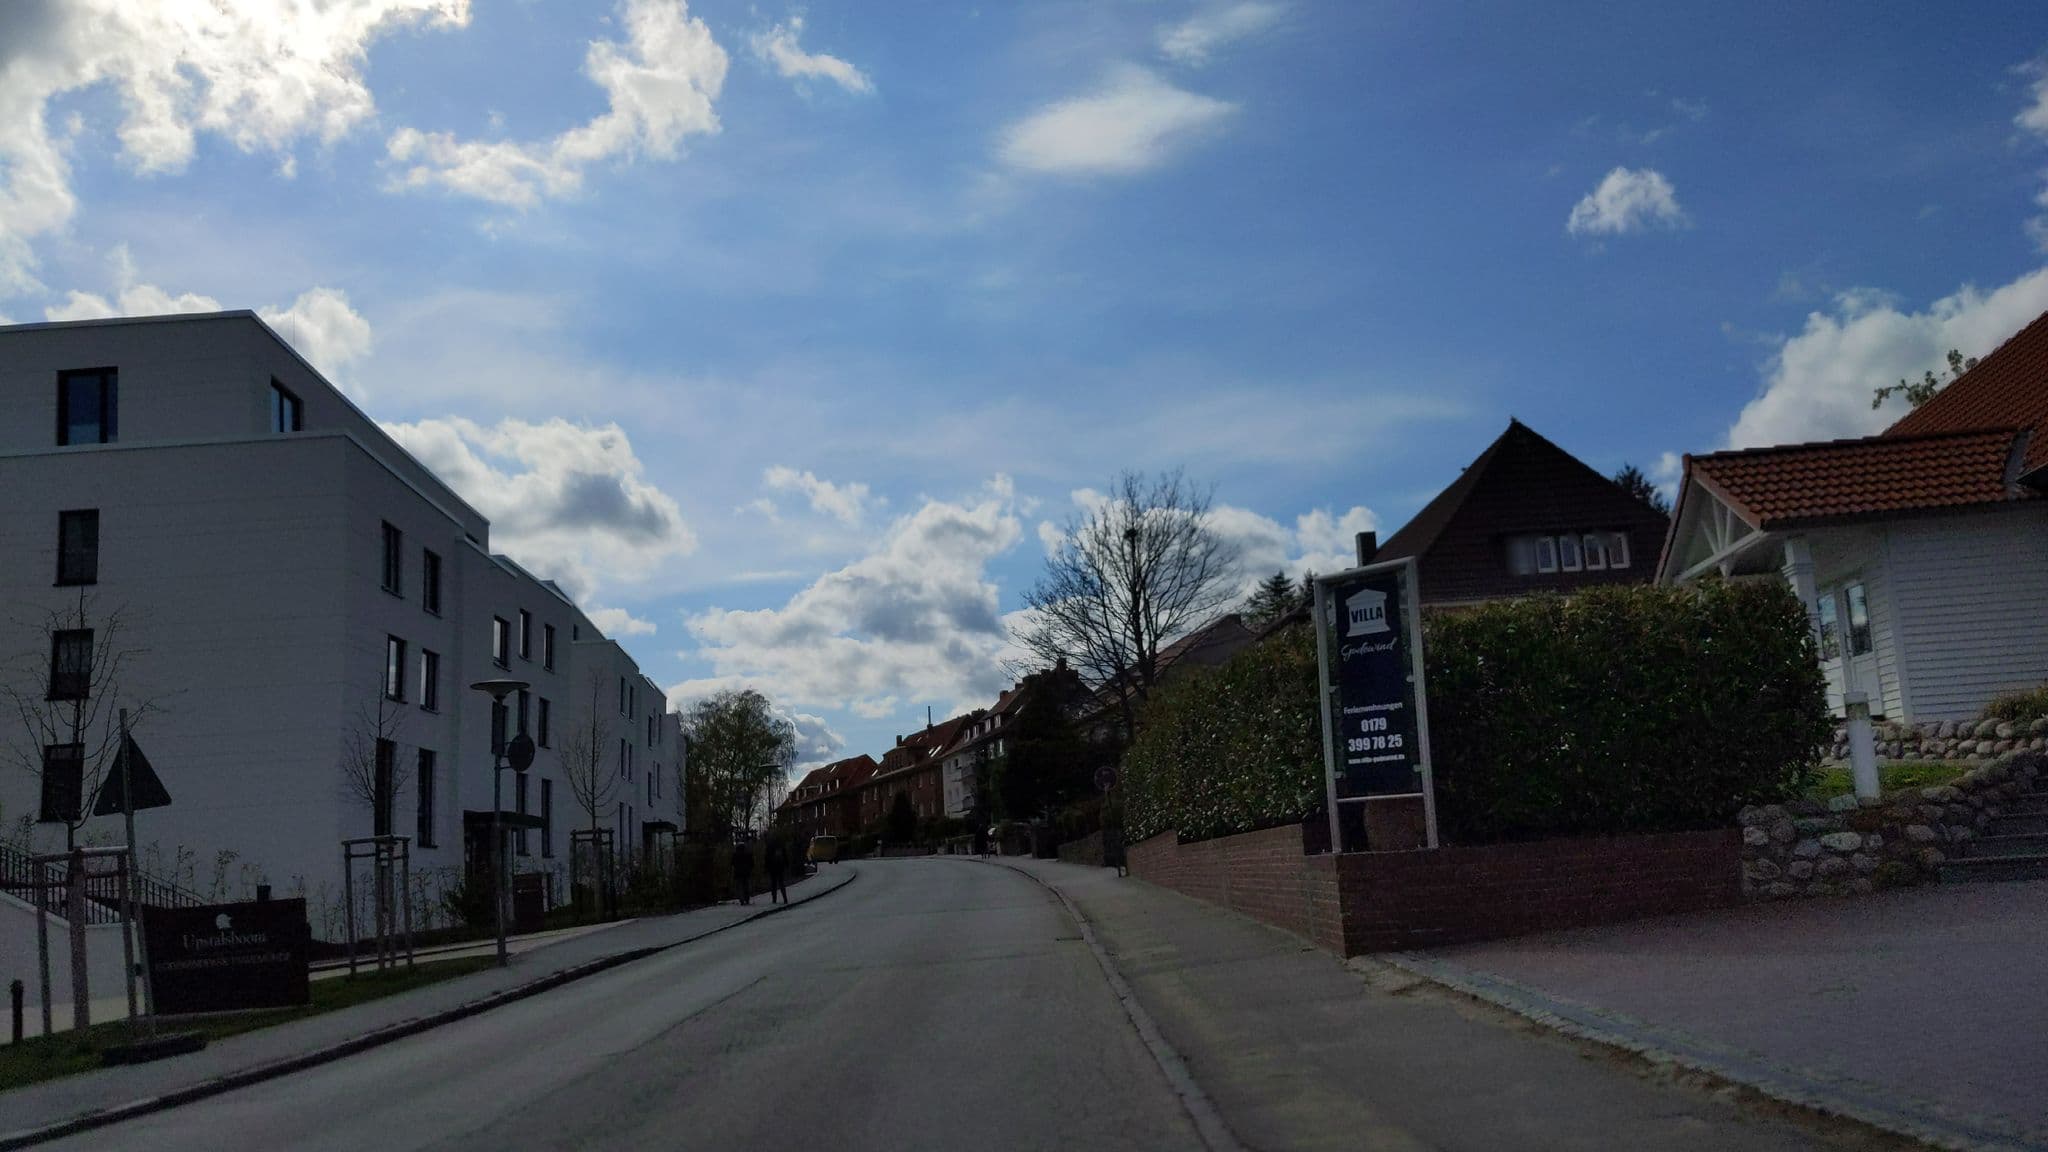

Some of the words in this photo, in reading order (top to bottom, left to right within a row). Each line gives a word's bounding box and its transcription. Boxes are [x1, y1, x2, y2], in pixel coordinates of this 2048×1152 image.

[1351, 606, 1383, 623] VILLA
[1361, 717, 1387, 732] 0179
[1348, 737, 1371, 752] 399
[1371, 735, 1386, 750] 78
[1387, 733, 1403, 748] 25
